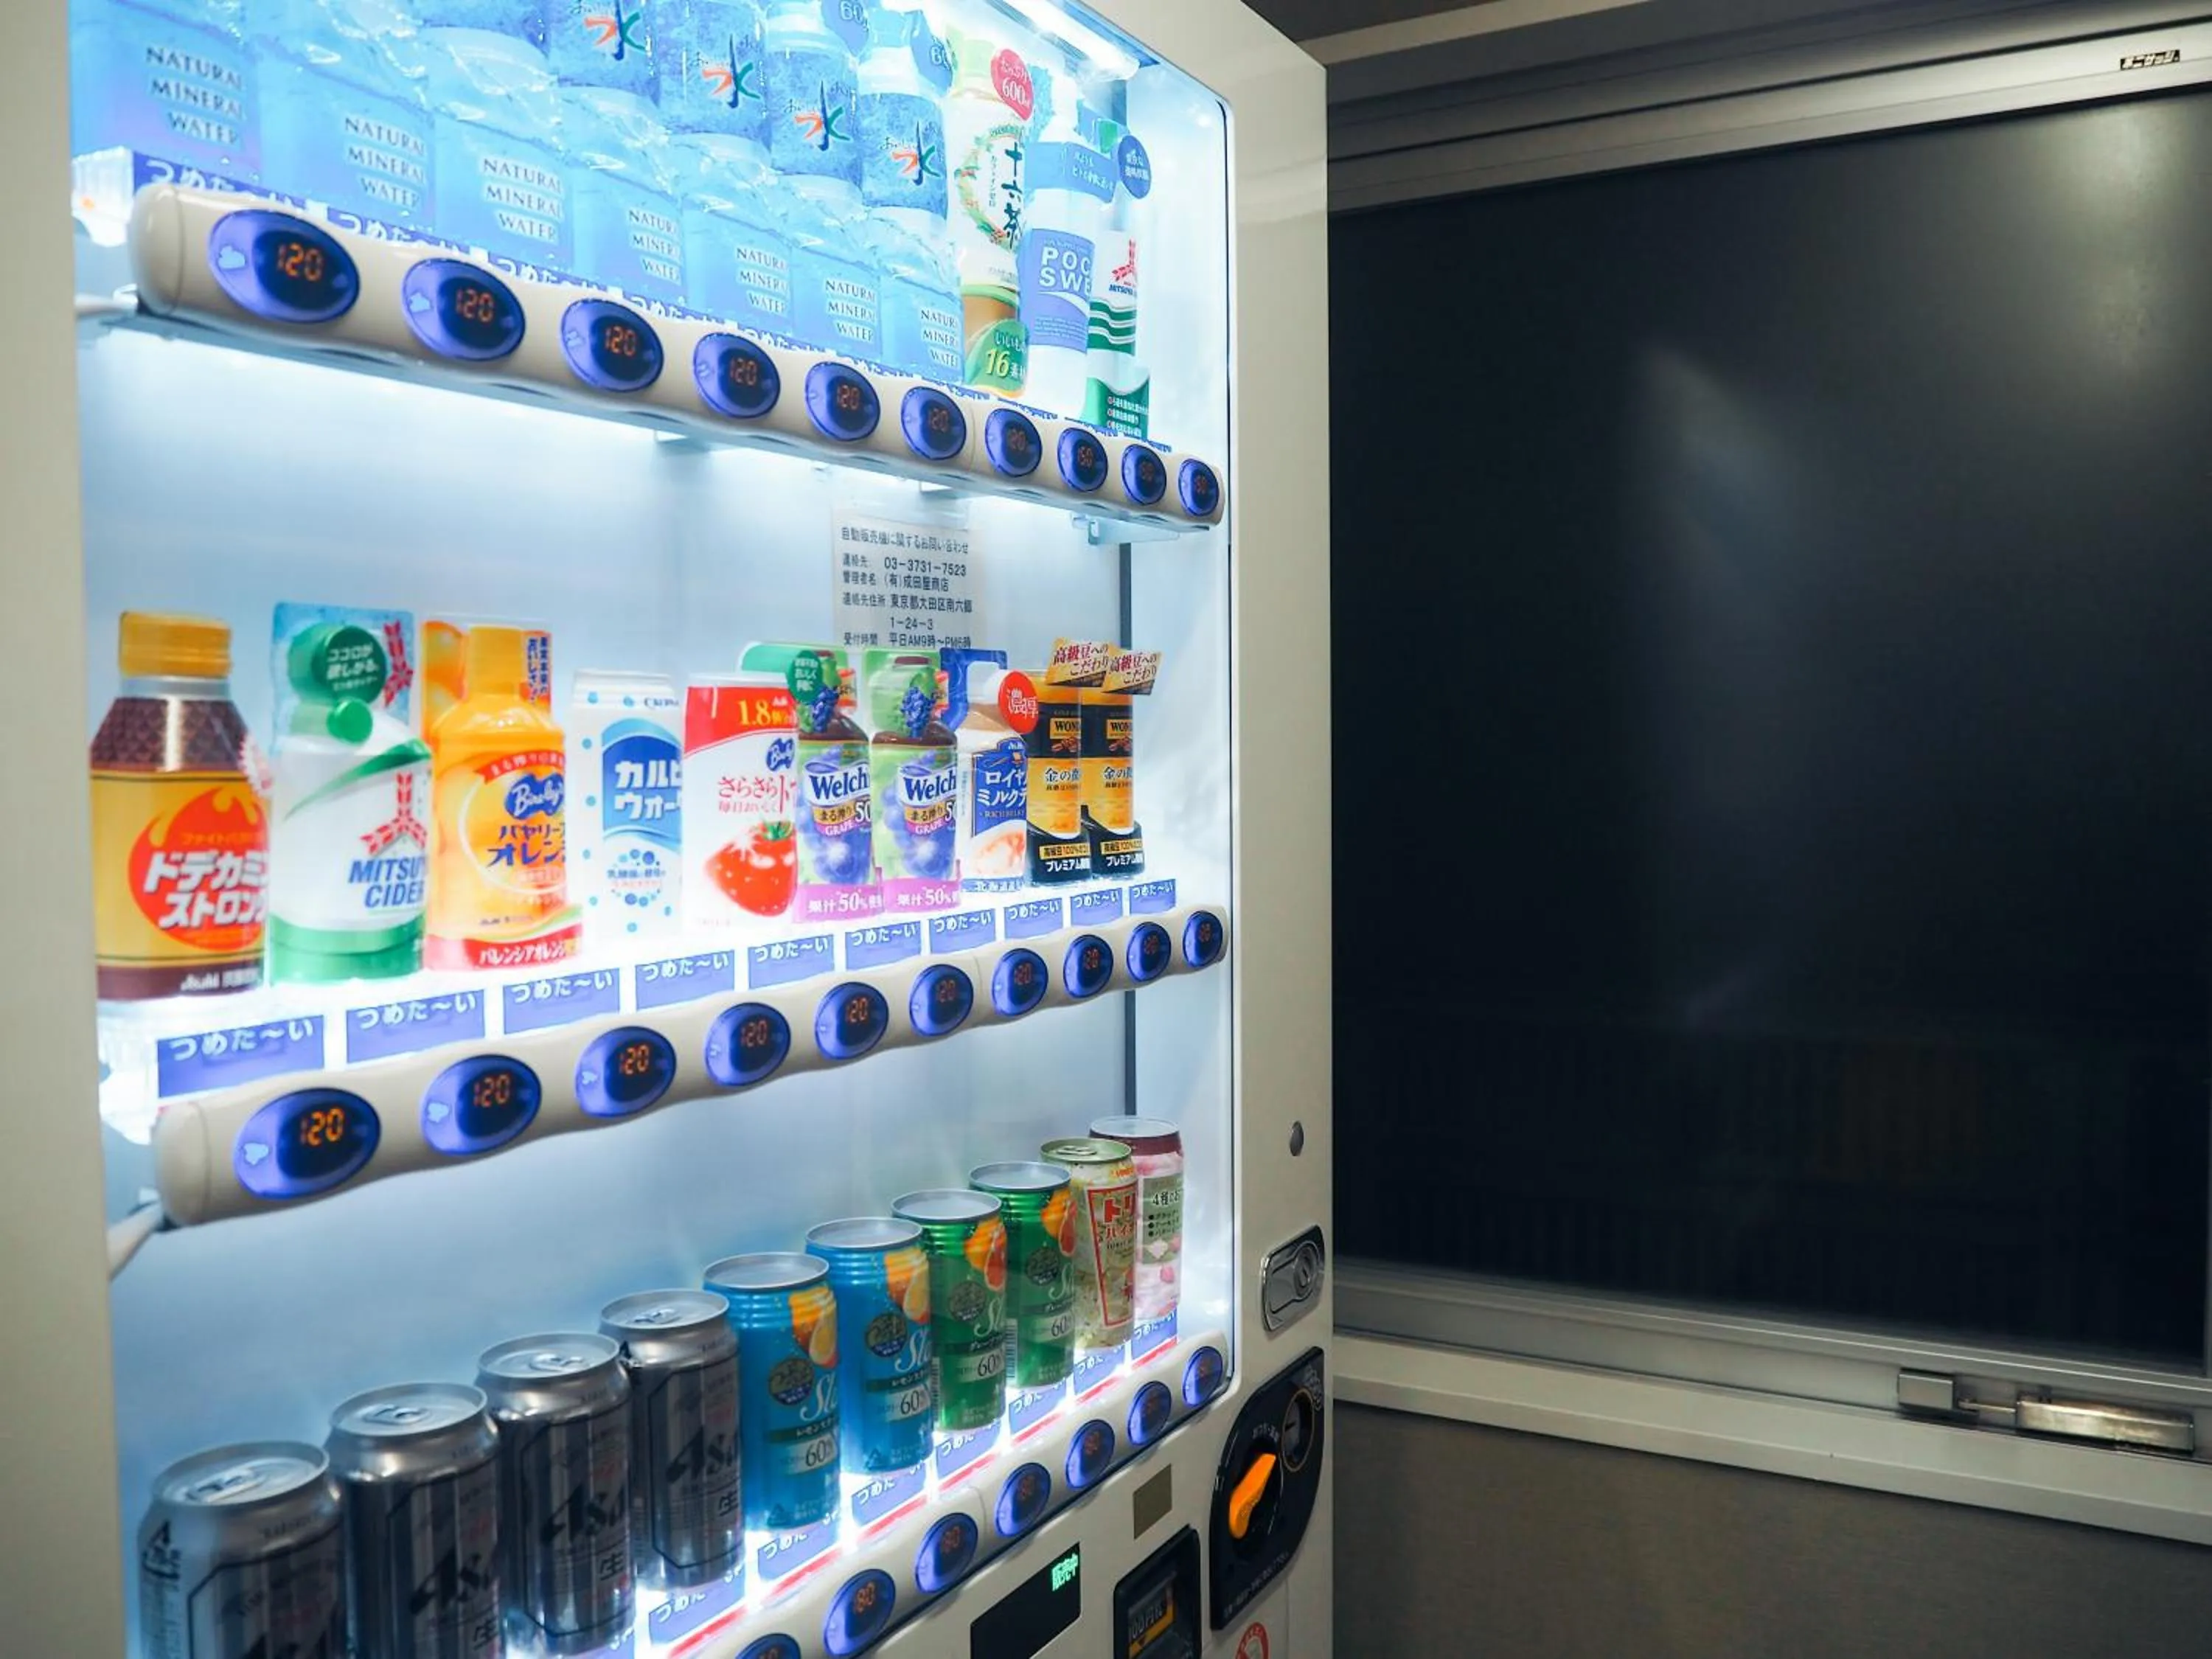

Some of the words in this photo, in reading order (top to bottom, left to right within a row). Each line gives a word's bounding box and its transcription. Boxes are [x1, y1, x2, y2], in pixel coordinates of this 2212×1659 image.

[277, 243, 325, 282] 120
[455, 288, 495, 323] 120
[603, 324, 638, 357] 120
[729, 357, 758, 386] 120
[884, 557, 966, 577] 03-3731-7523
[890, 616, 933, 630] 1-24-3
[614, 791, 681, 820] ウォー
[143, 849, 269, 894] ドデカミ
[740, 1020, 768, 1048] 120
[619, 1043, 650, 1075] 120
[473, 1074, 511, 1109] 120
[300, 1107, 345, 1147] 120
